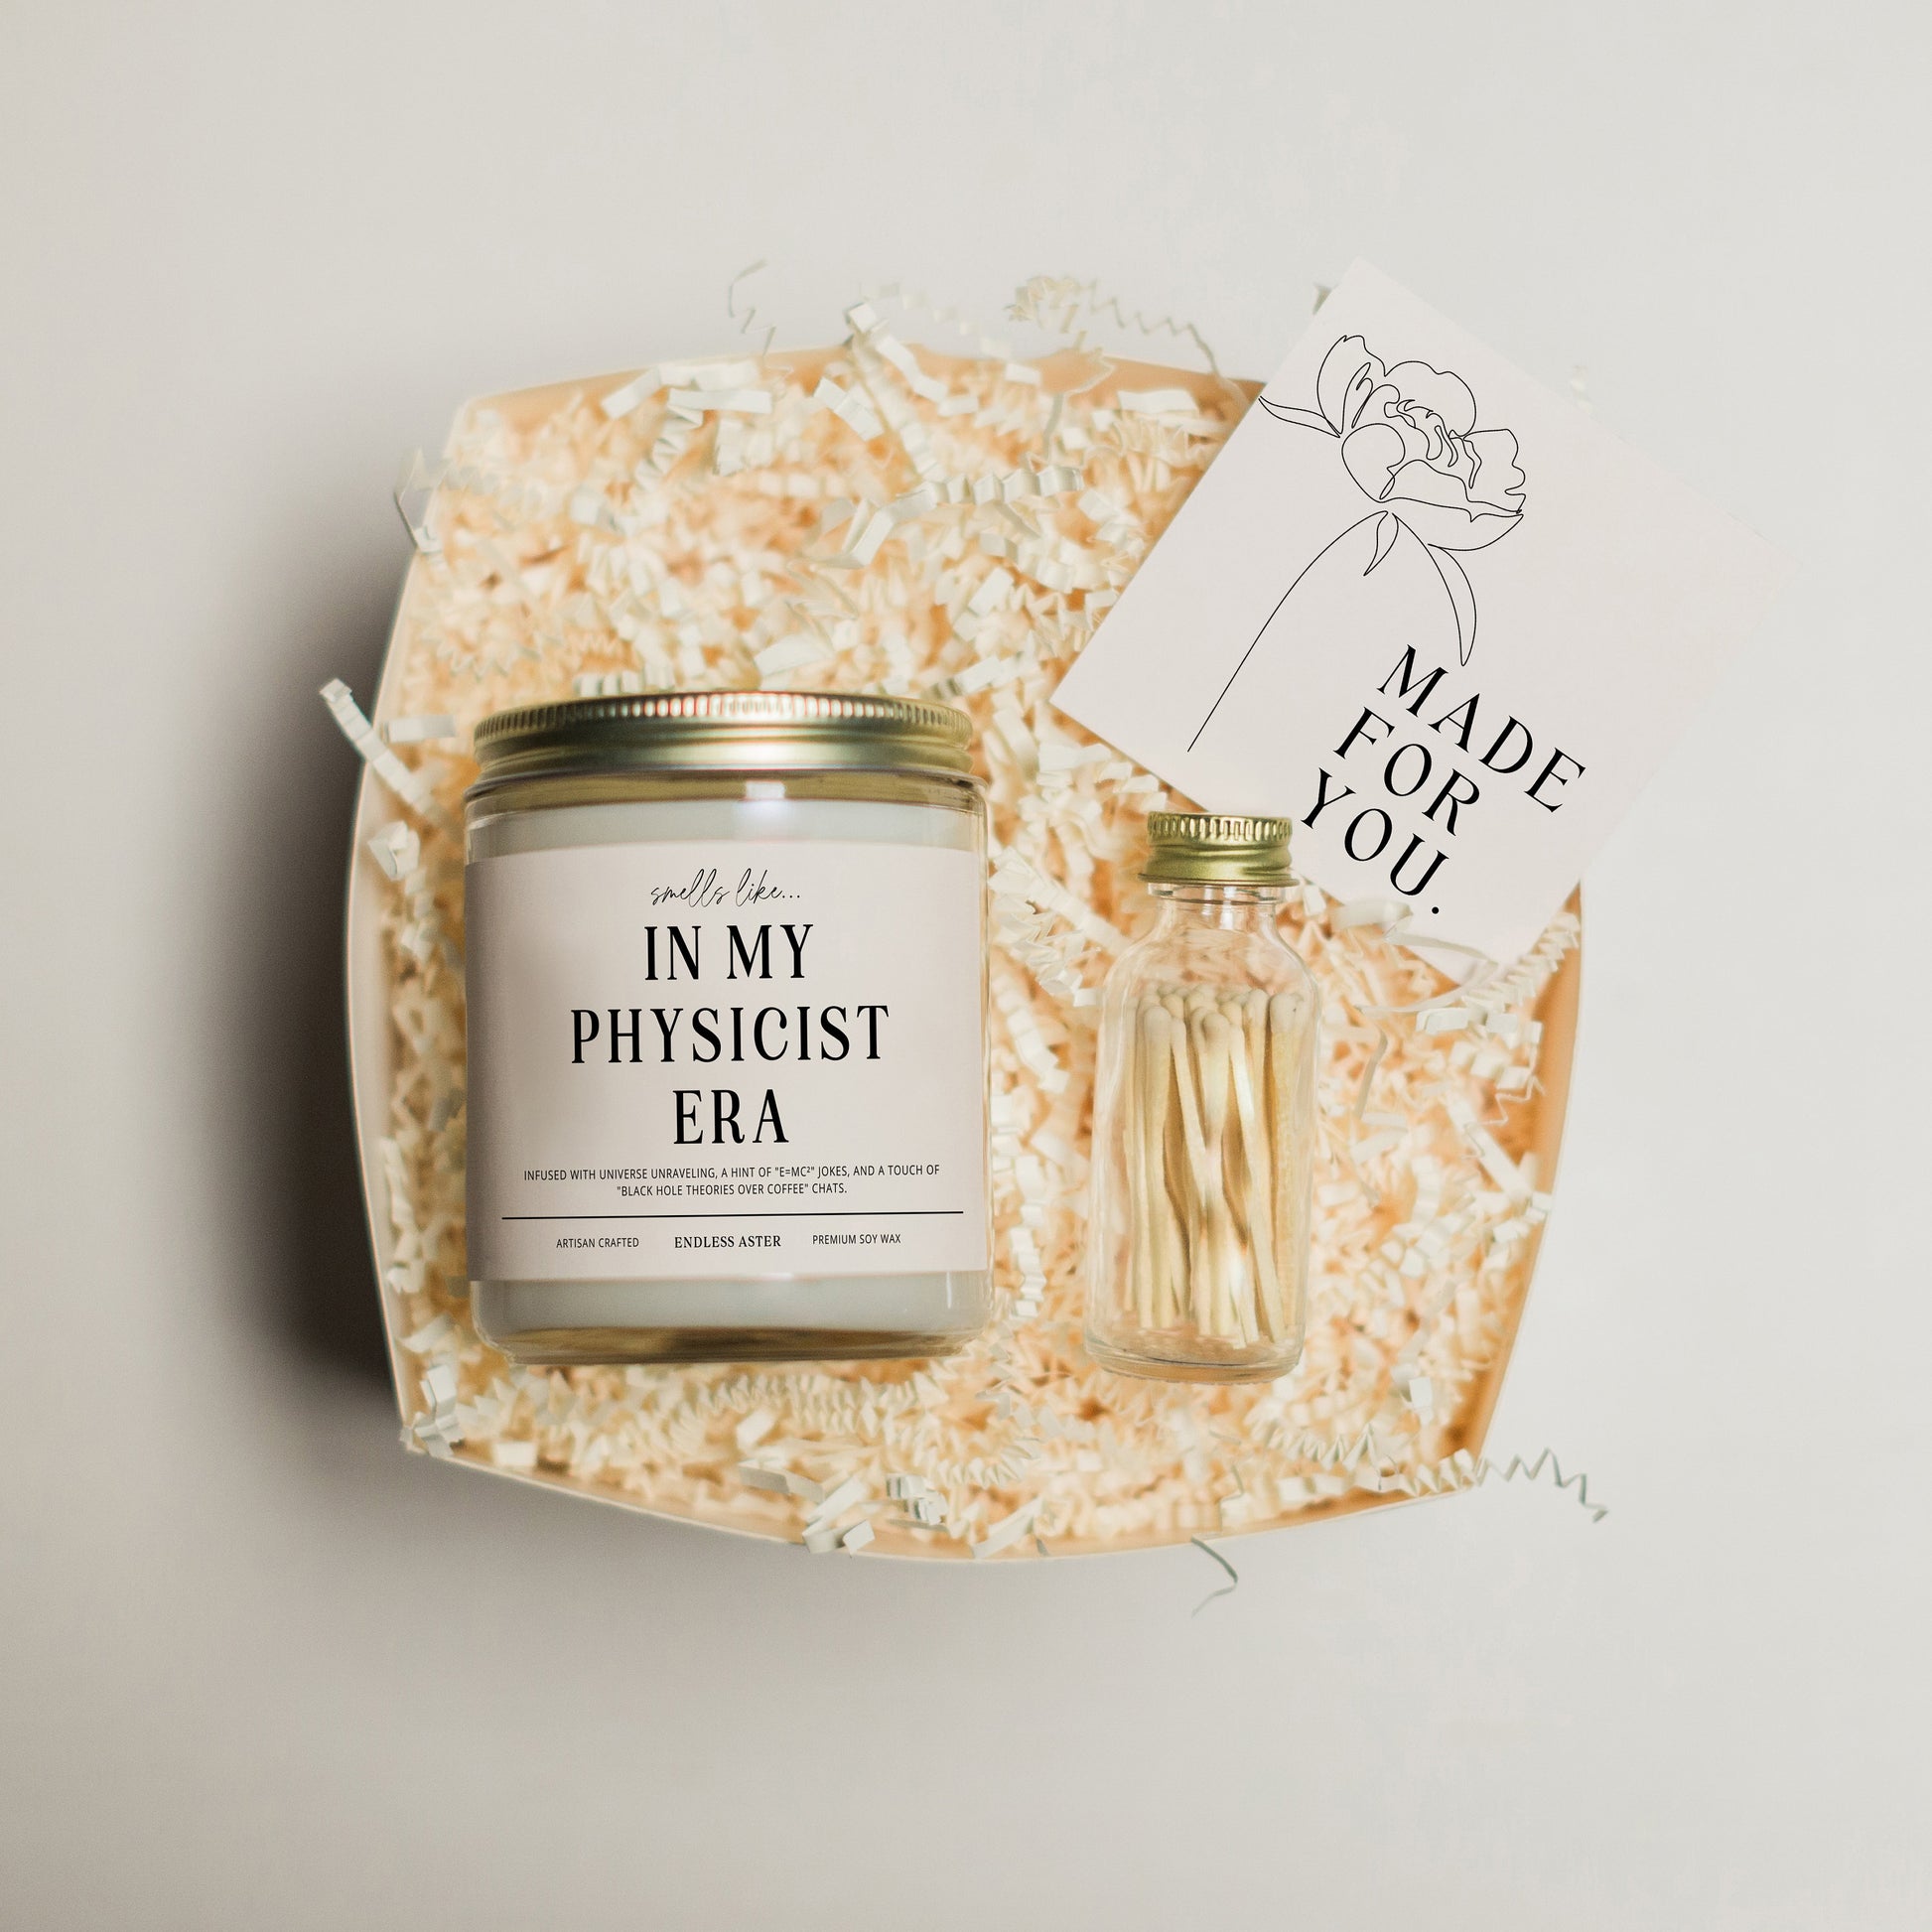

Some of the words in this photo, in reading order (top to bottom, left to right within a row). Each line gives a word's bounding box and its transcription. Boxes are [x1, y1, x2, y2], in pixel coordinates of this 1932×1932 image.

[1376, 644, 1586, 812] MADE
[1333, 707, 1479, 836] FOR
[1301, 767, 1449, 914] YOU.
[651, 869, 730, 907] smells
[736, 868, 799, 906] like...
[644, 926, 701, 980] IN
[727, 924, 813, 979] MY
[570, 1006, 889, 1063] PHYSICIST
[672, 1089, 789, 1144] ERA
[523, 1169, 568, 1181] INFUSED
[569, 1169, 597, 1180] WITH
[599, 1168, 648, 1180] UNIVERSE
[650, 1167, 719, 1180] UNRAVELING,
[720, 1167, 729, 1178] A
[731, 1167, 756, 1178] HINT
[758, 1166, 772, 1178] OF
[816, 1165, 851, 1179] JOKES,
[852, 1165, 876, 1176] AND
[877, 1165, 886, 1176] A
[887, 1164, 923, 1176] TOUCH
[925, 1164, 940, 1175] OF
[617, 1184, 653, 1197] "BLACK
[655, 1184, 683, 1196] HOLE
[685, 1183, 735, 1196] THEORIES
[737, 1183, 764, 1195] OVER
[766, 1182, 809, 1195] COFFEE"
[811, 1181, 848, 1194] CHATS.
[555, 1237, 596, 1249] ARTISAN
[598, 1237, 639, 1249] CRAFTED
[674, 1235, 735, 1249] ENDLESS
[738, 1234, 782, 1248] ASTER
[812, 1234, 857, 1245] PREMIUM
[859, 1233, 879, 1245] SOY
[880, 1233, 901, 1244] WAX
